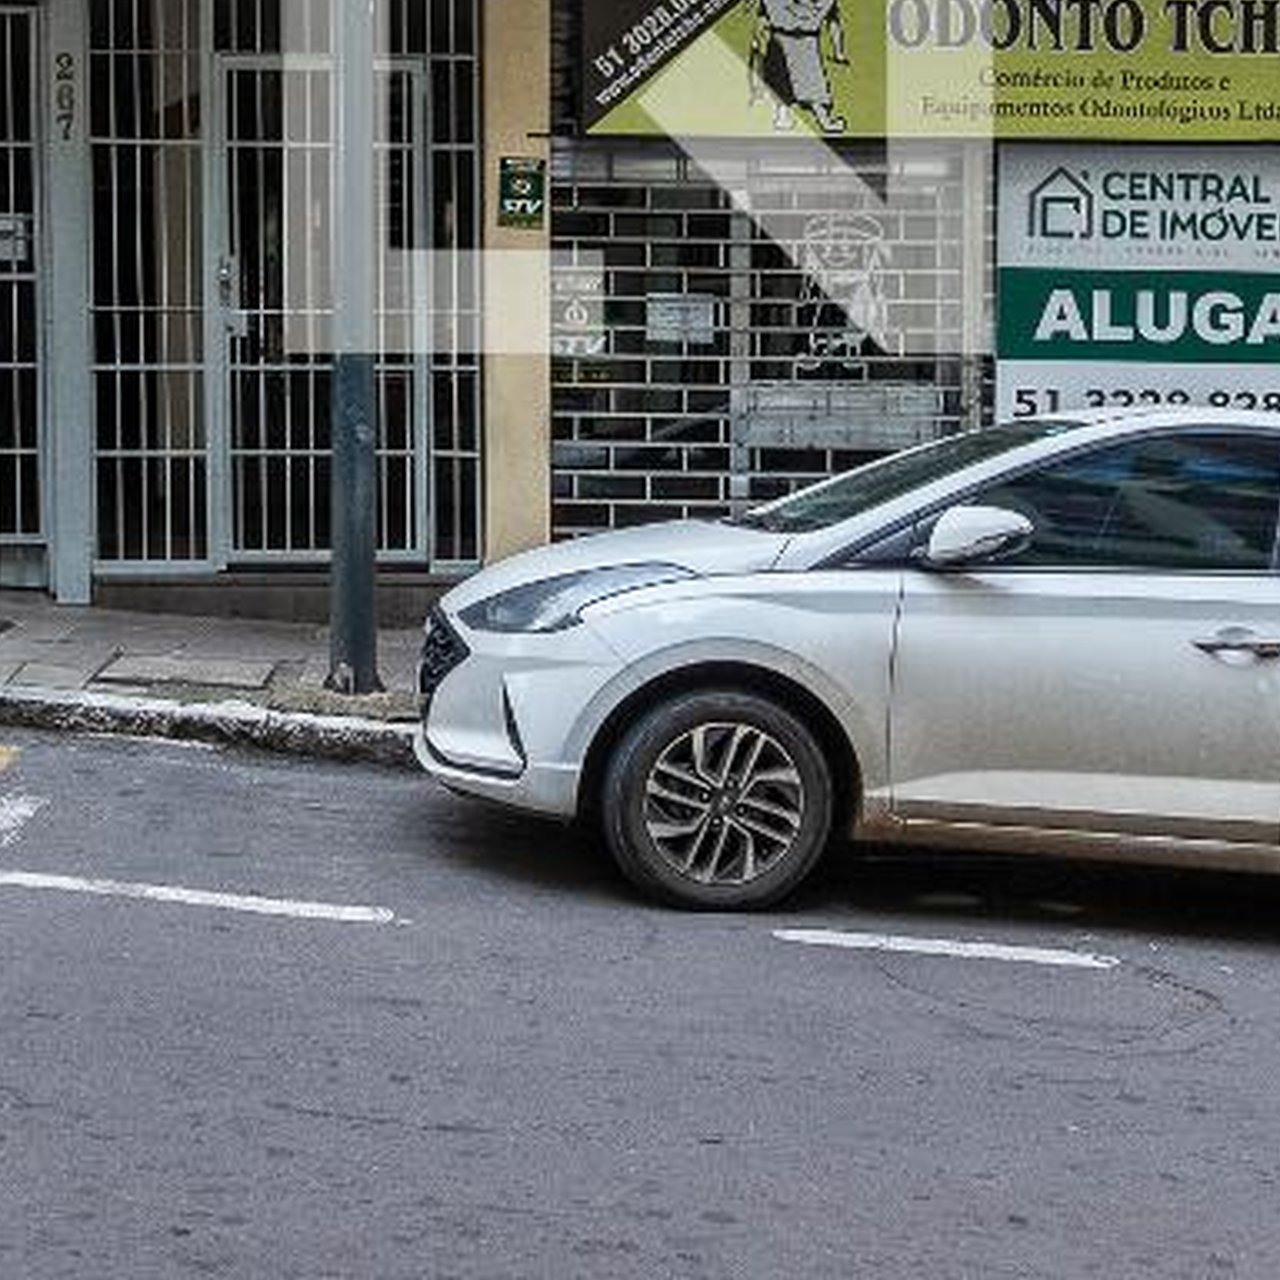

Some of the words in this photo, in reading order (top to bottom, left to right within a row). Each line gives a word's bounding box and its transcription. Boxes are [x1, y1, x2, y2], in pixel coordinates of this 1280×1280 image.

[980, 68, 1084, 89] Comércio
[1092, 69, 1114, 89] de
[1121, 70, 1213, 91] Produtos
[1218, 77, 1231, 91] e
[921, 96, 1074, 121] Equipamentos
[1080, 98, 1230, 123] Odontológicos
[1102, 171, 1271, 204] CENTRAL
[1101, 209, 1150, 239] DE
[1013, 389, 1060, 418] 51
